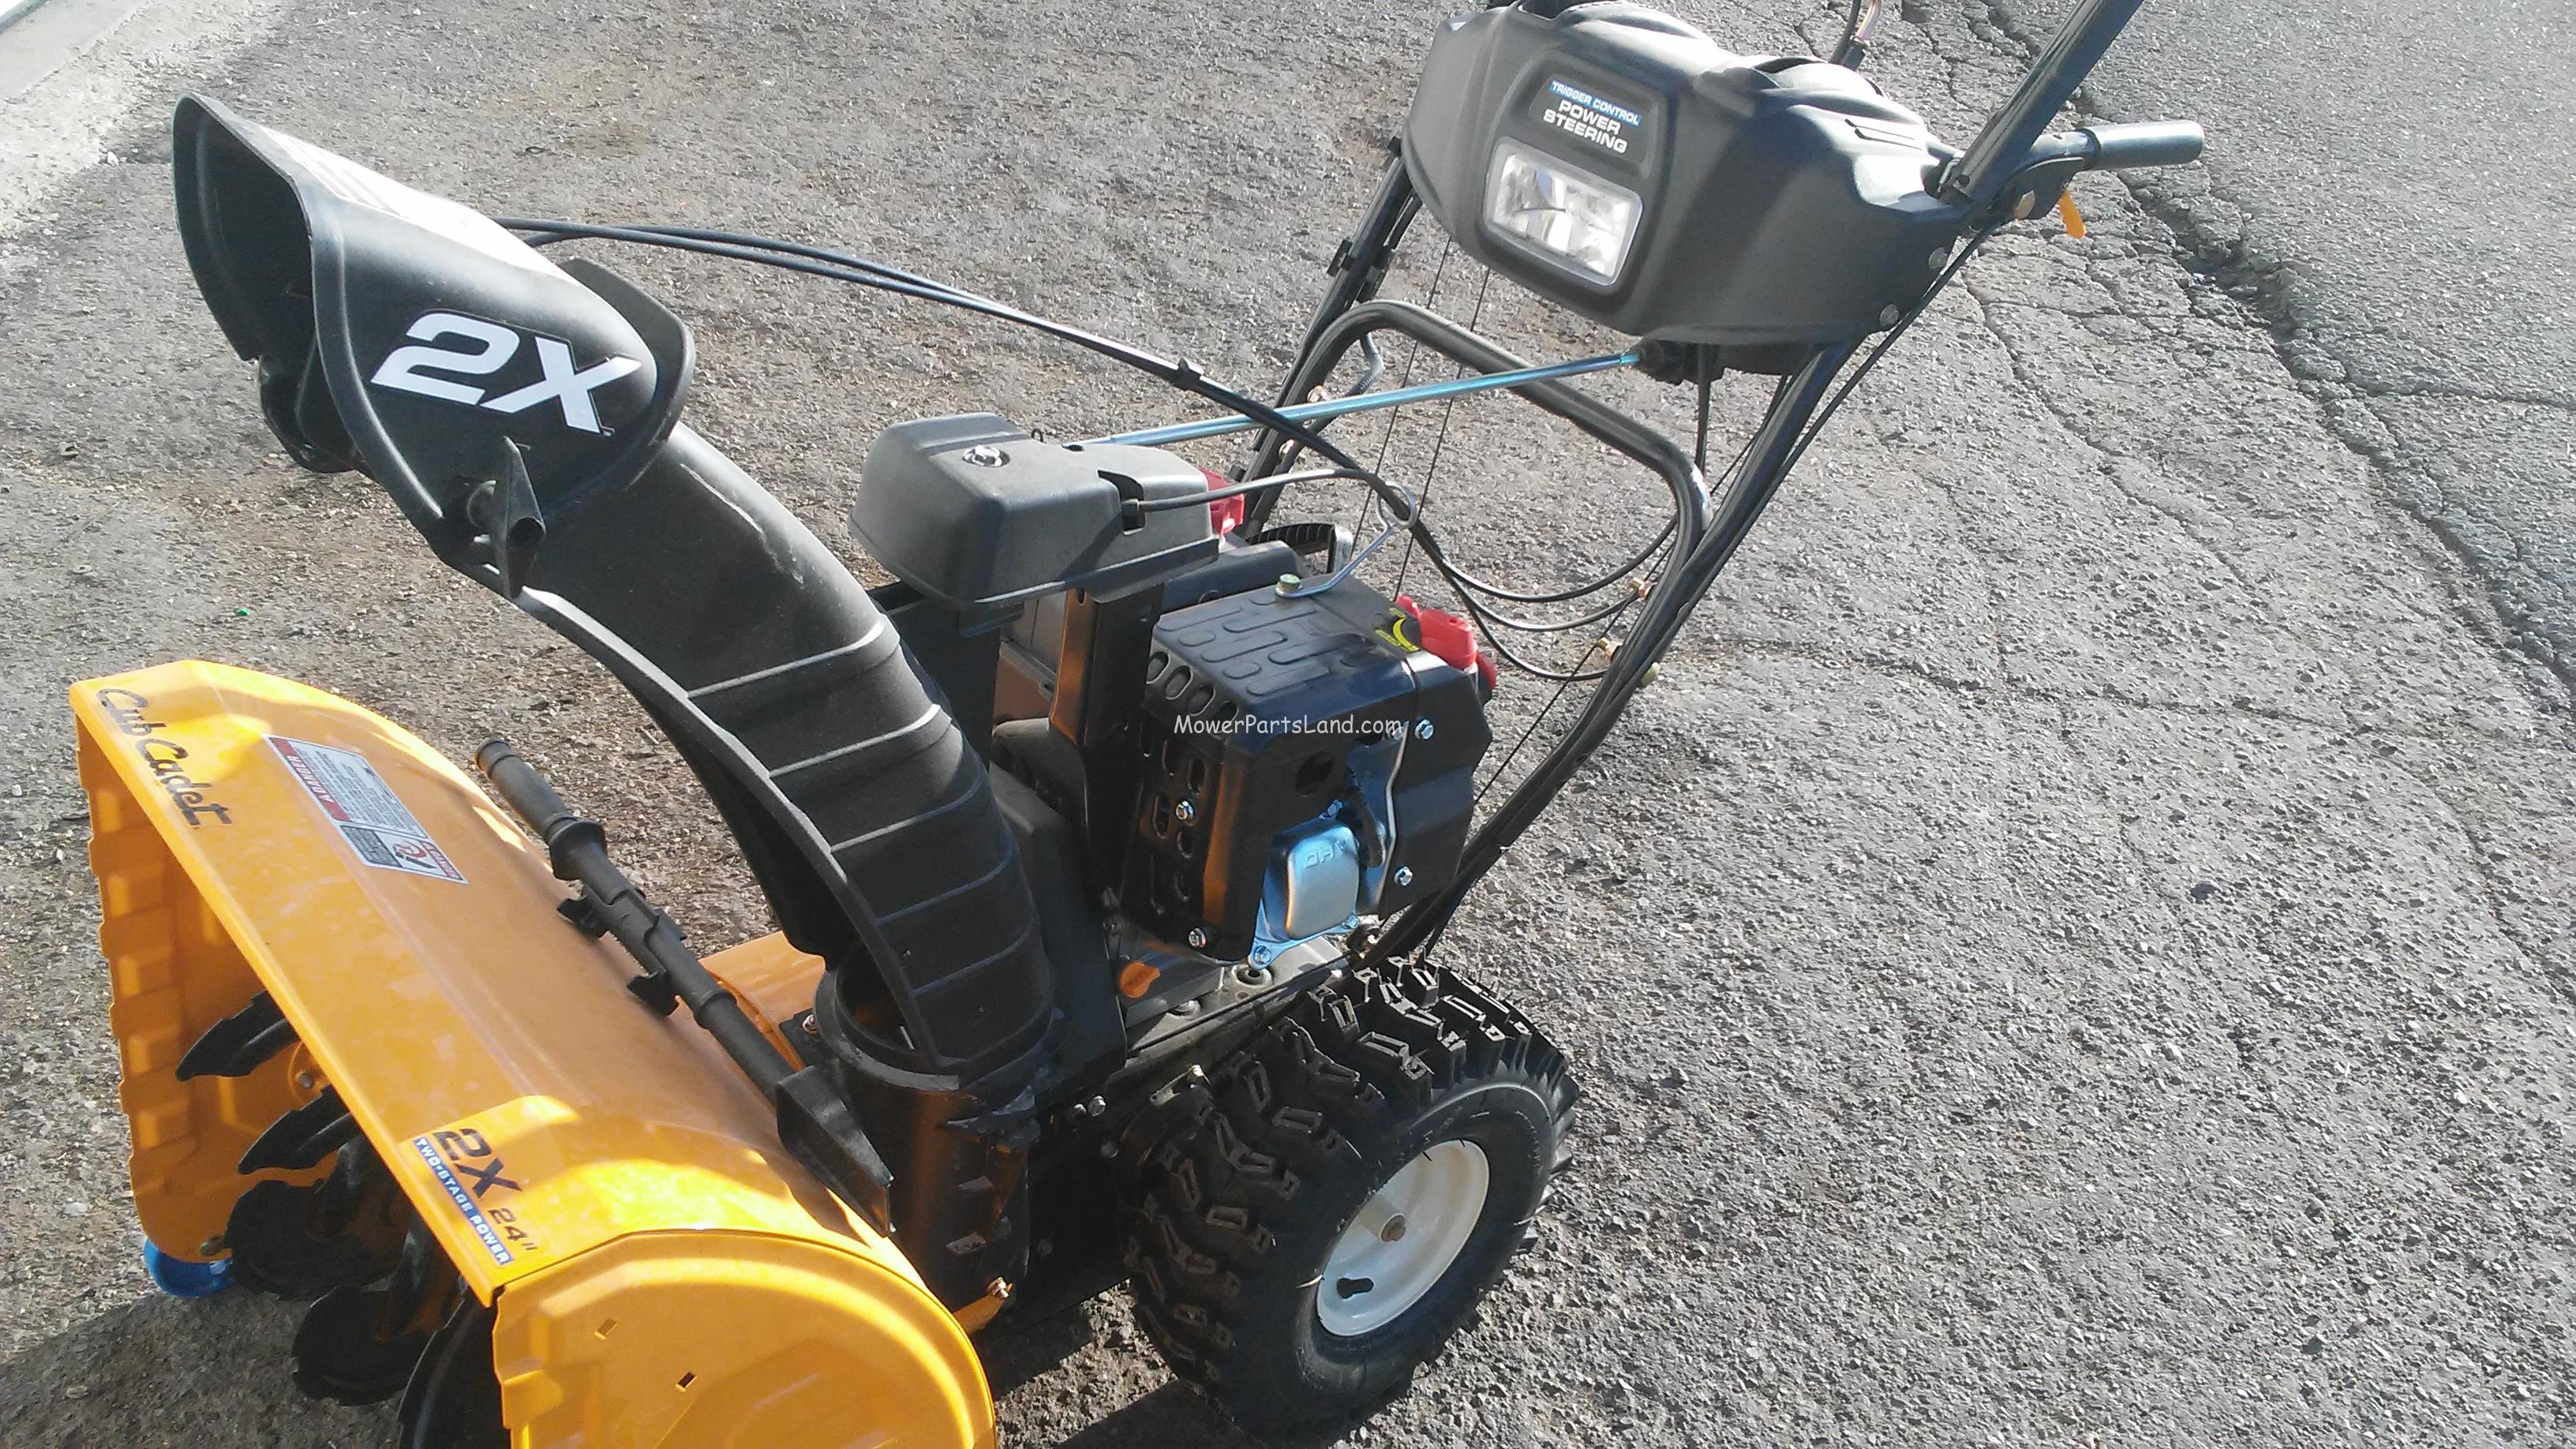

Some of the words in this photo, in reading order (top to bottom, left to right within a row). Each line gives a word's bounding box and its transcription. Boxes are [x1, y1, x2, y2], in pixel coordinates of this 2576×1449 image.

[1551, 80, 1592, 104] TRIGGER
[1593, 99, 1640, 125] CONTROL
[1559, 99, 1621, 135] POWER
[1543, 108, 1628, 154] STEERING
[370, 313, 642, 434] 2X
[95, 687, 167, 736] Cub
[135, 738, 232, 826] Cadet
[432, 1129, 522, 1199] 2X
[470, 1215, 511, 1264] POWER
